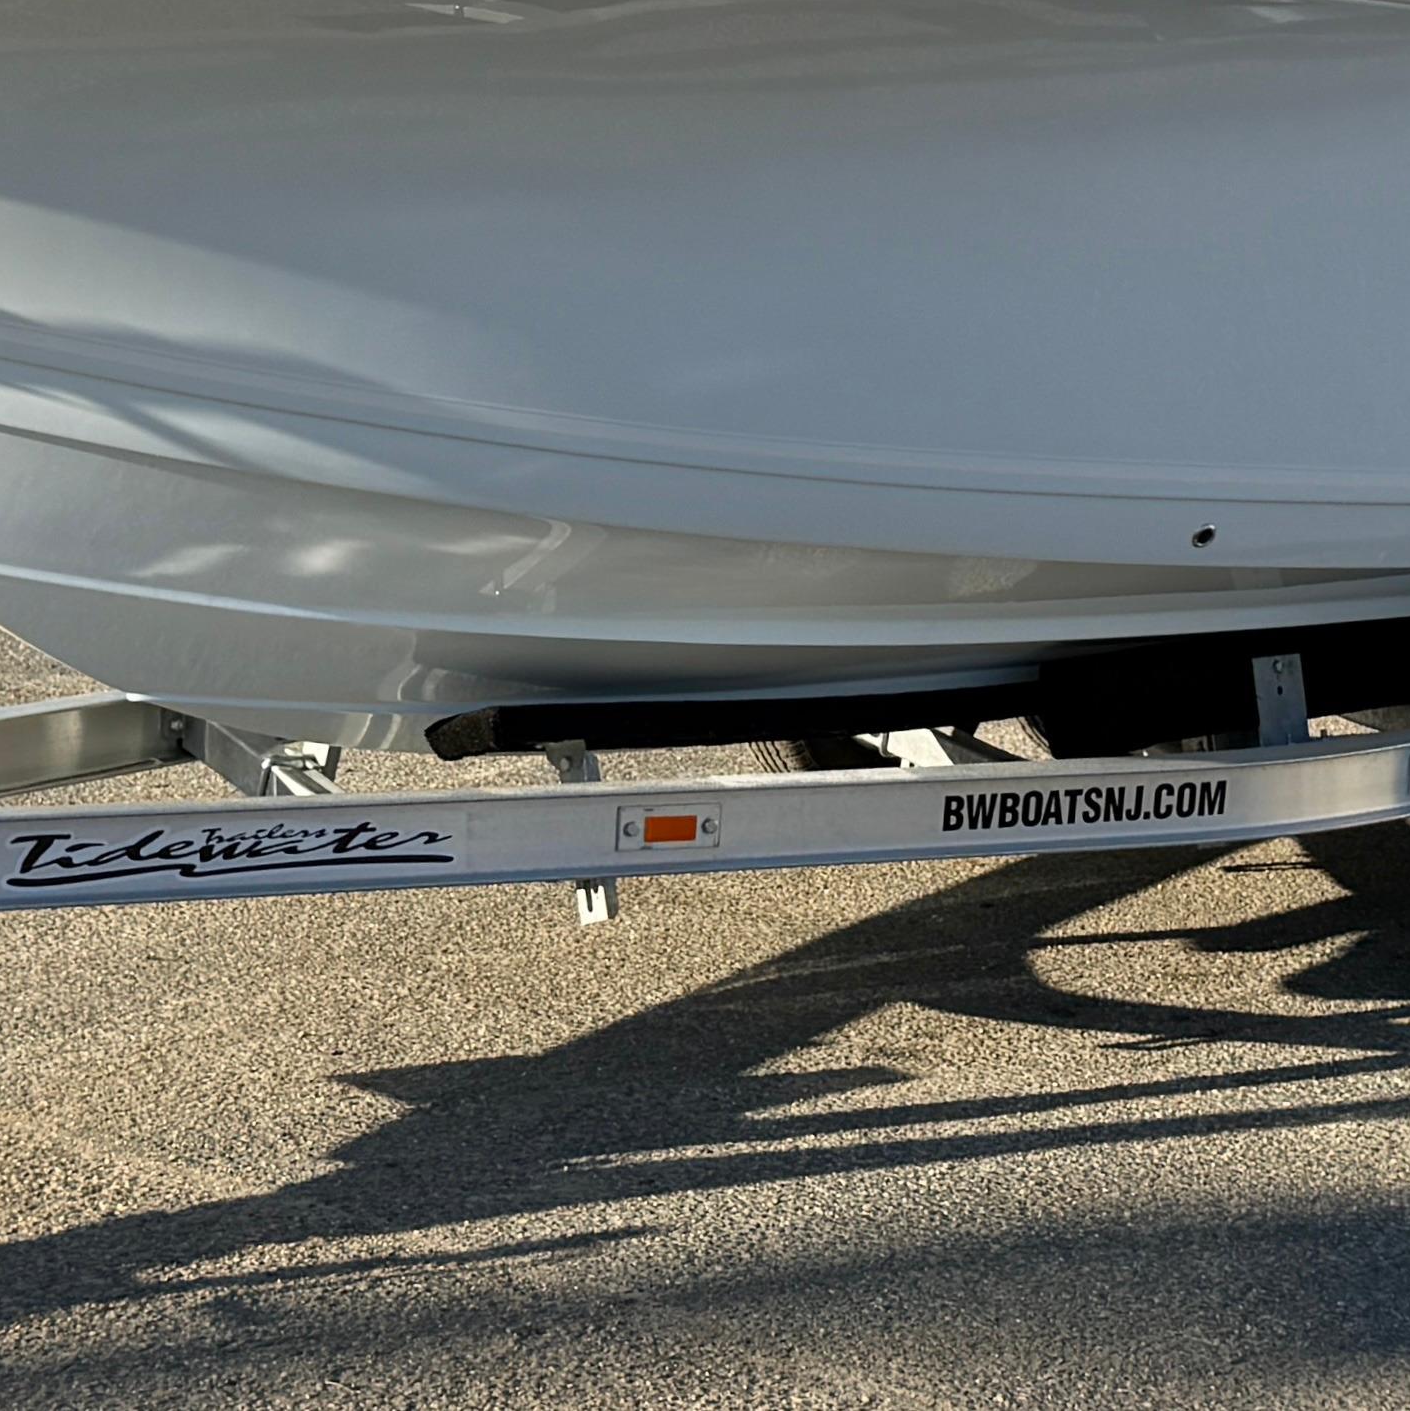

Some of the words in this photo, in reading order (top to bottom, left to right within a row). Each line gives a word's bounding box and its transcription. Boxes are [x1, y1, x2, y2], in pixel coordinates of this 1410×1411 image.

[941, 780, 1228, 833] BWBOATSNJ.COM
[10, 820, 453, 876] Tidewater
[202, 823, 326, 846] Trailers
